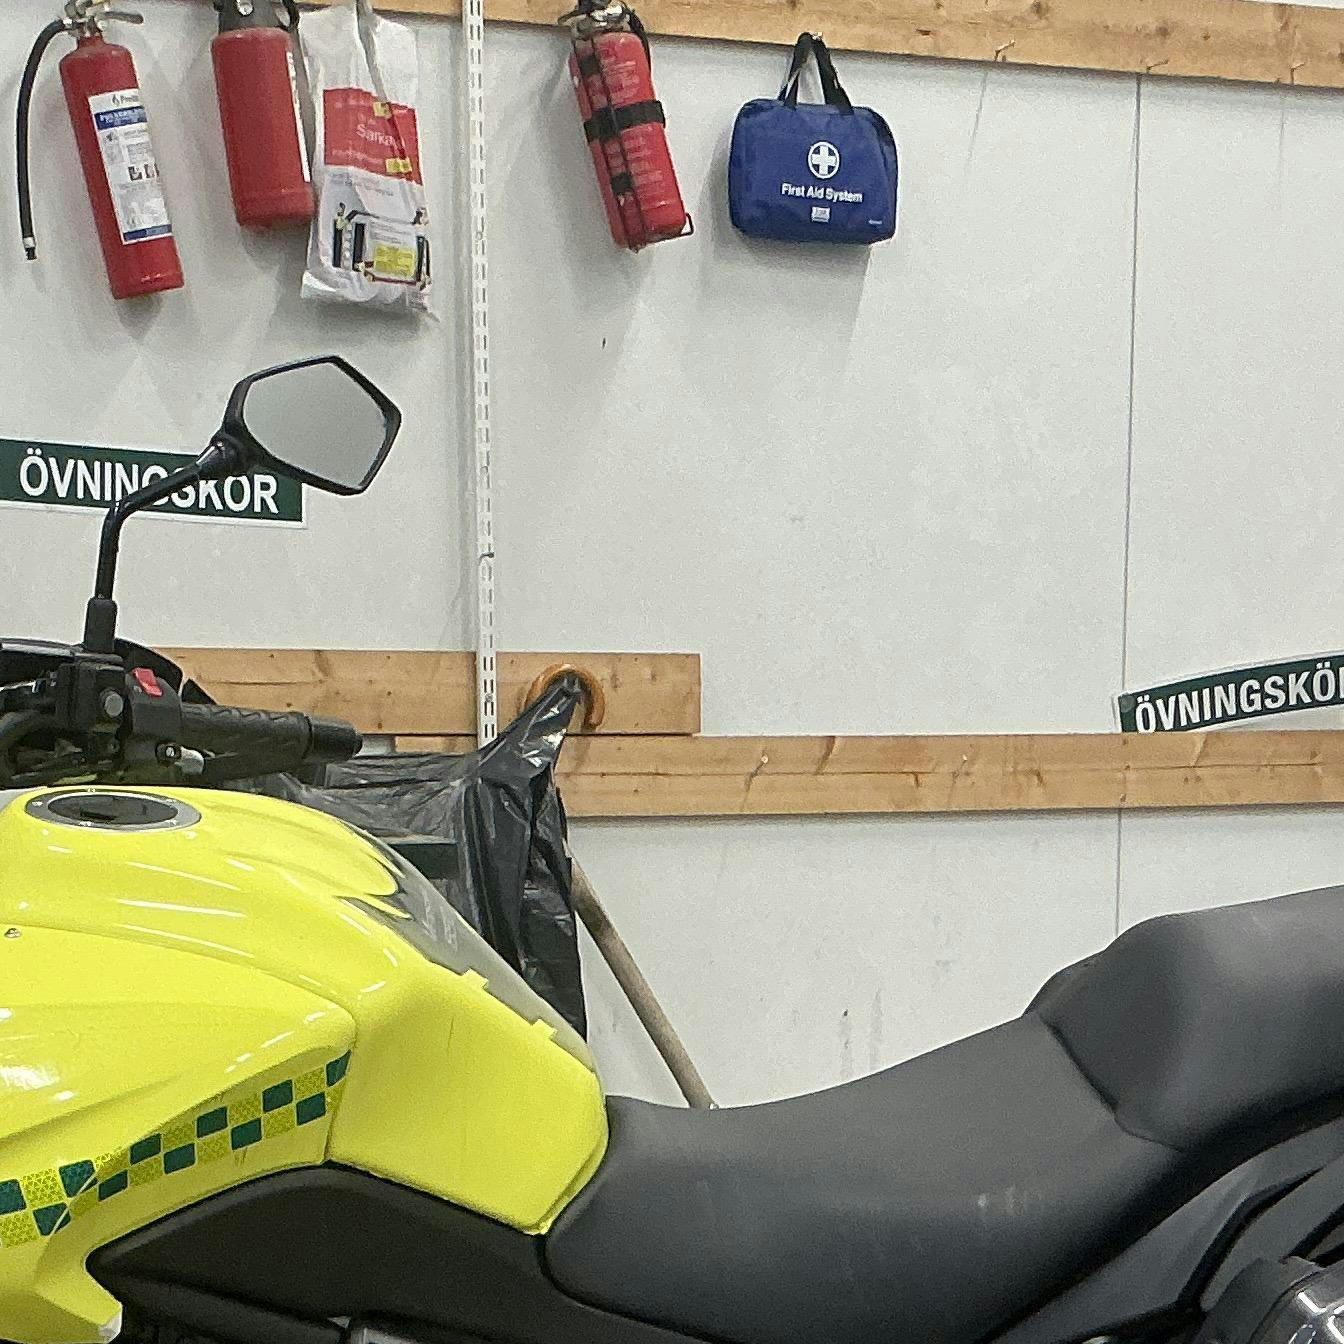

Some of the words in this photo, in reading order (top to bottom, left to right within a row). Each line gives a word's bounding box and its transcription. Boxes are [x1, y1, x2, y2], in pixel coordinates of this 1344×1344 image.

[782, 182, 805, 198] First
[806, 185, 824, 199] Aid
[825, 187, 863, 203] System
